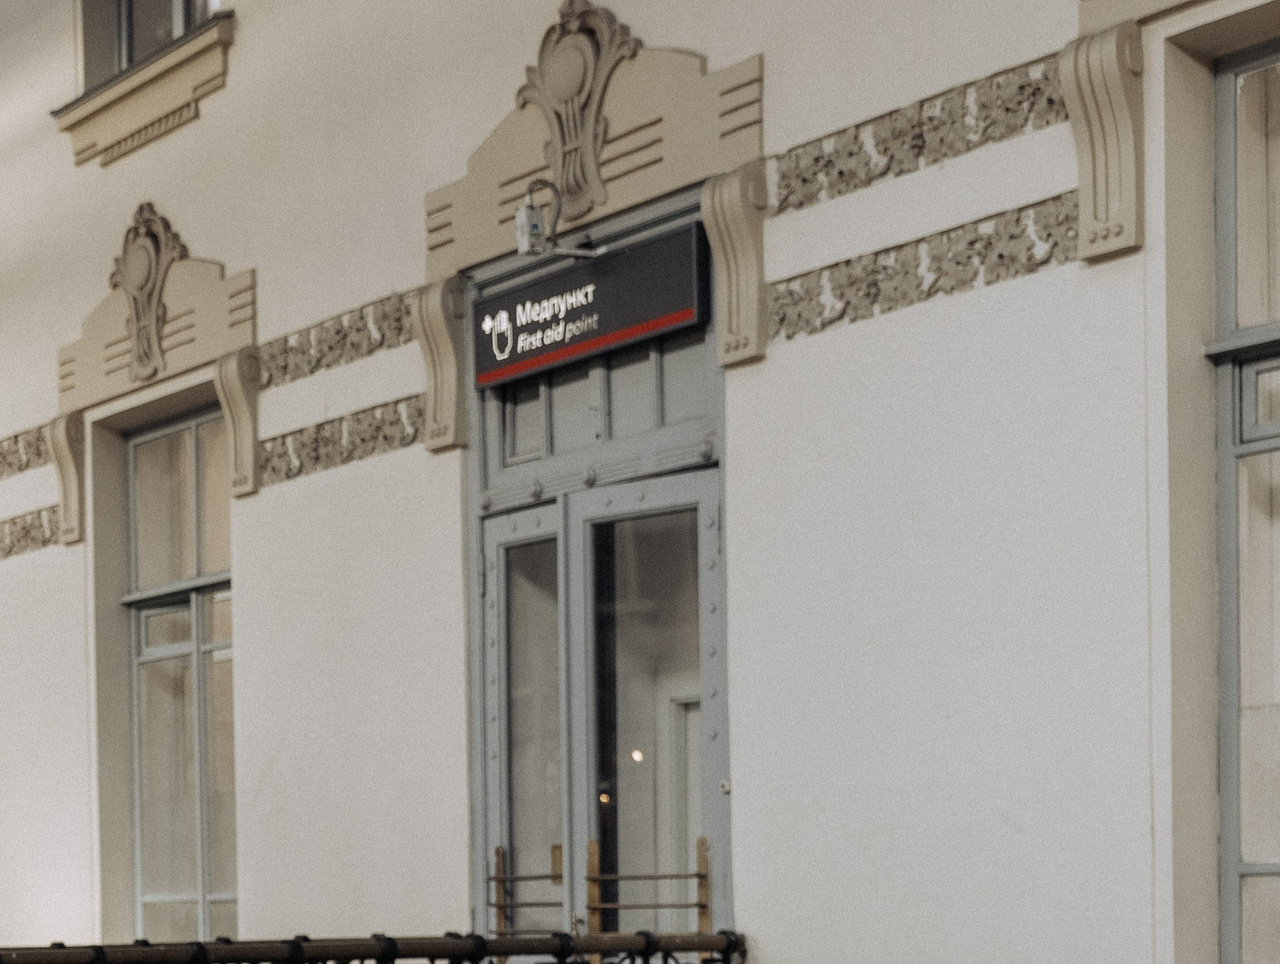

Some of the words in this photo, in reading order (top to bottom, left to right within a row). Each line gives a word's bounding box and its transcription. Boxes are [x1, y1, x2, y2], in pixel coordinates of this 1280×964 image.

[516, 283, 596, 327] Медпункт
[517, 329, 543, 354] First
[543, 319, 564, 345] aid
[565, 313, 599, 343] point
